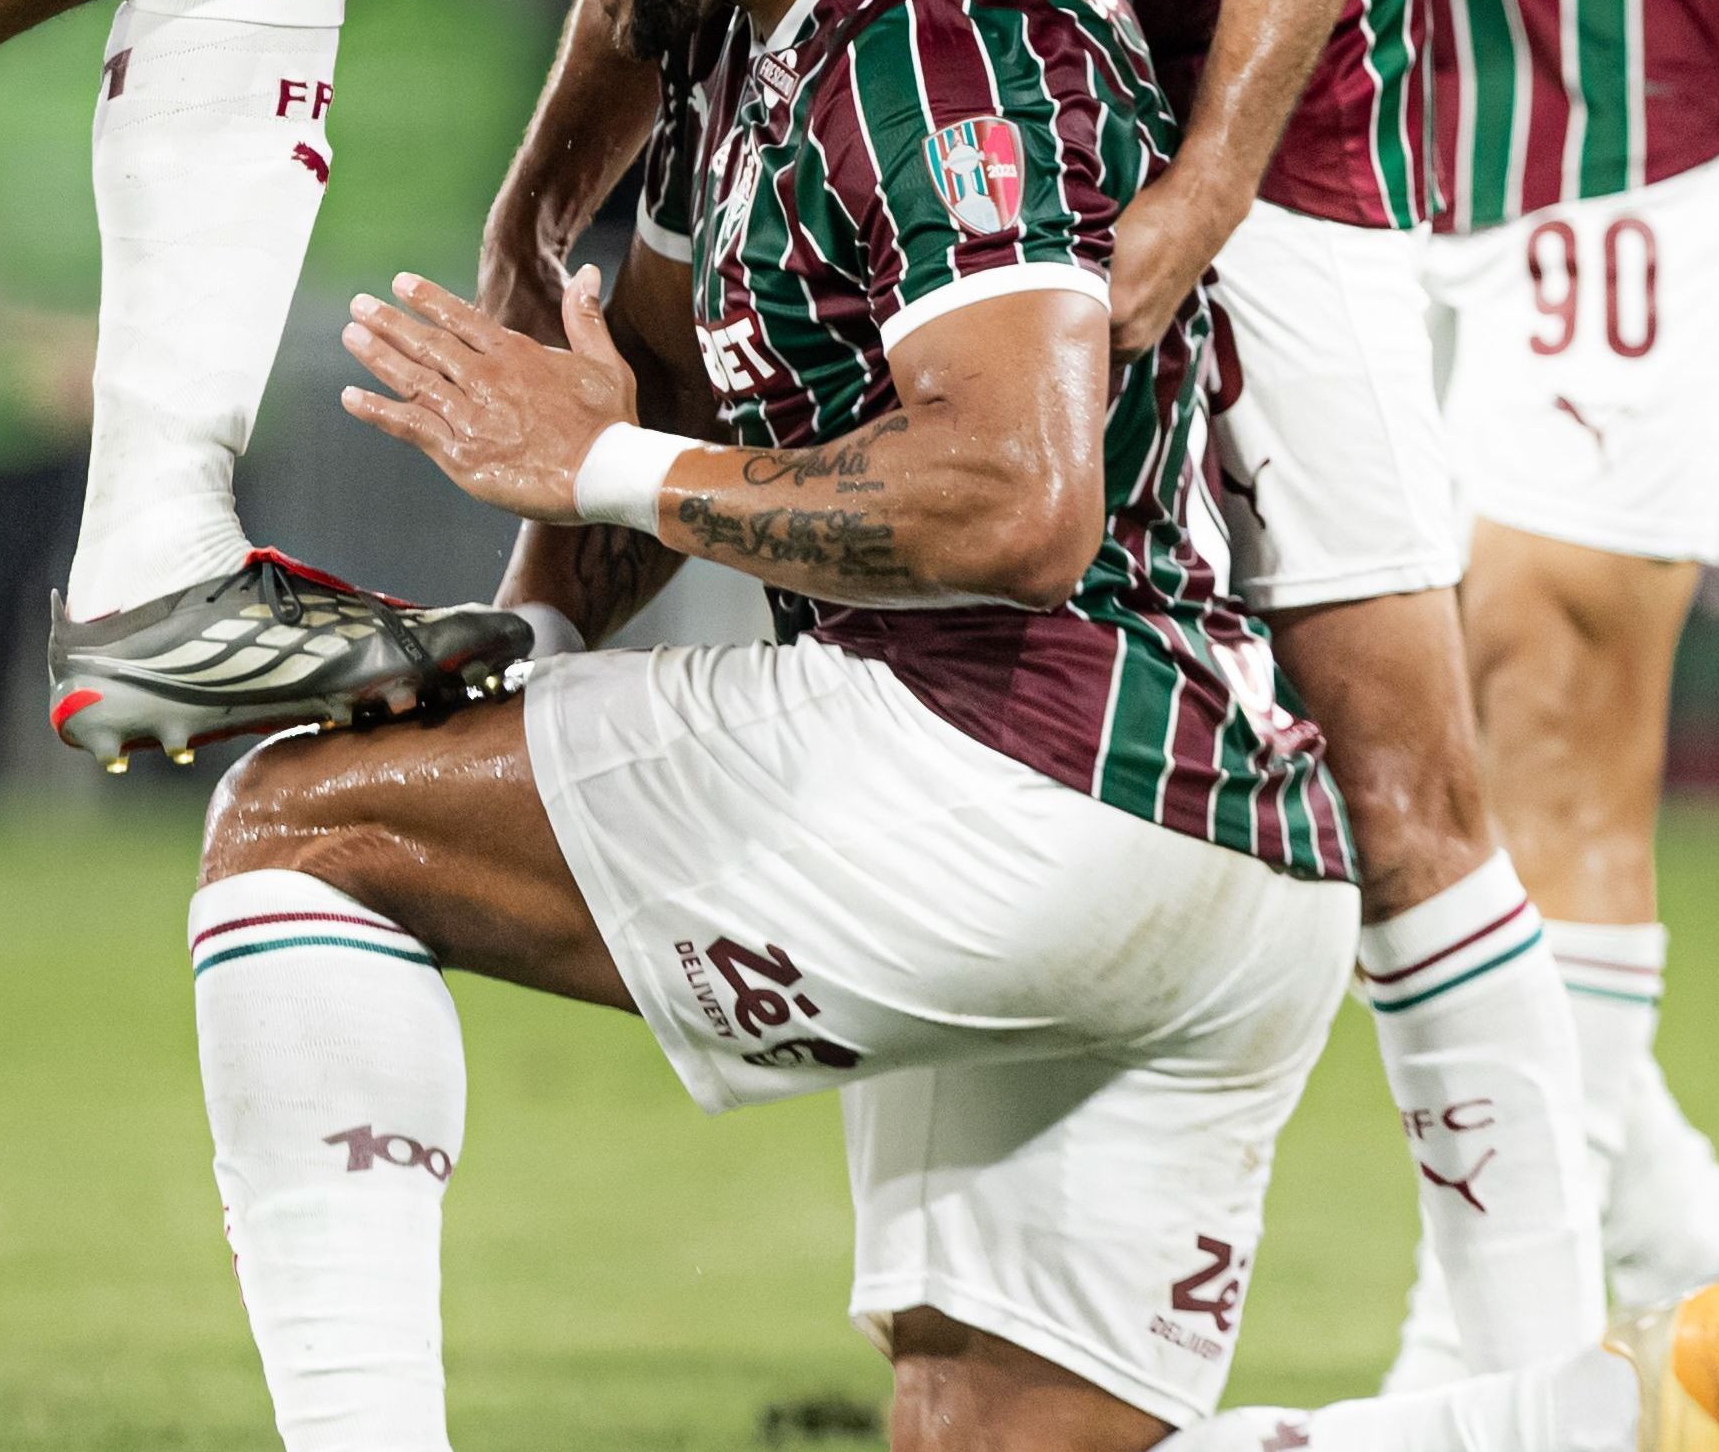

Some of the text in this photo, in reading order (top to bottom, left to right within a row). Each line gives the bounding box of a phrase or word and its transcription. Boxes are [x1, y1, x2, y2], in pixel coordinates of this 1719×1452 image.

[1528, 218, 1657, 358] 90
[674, 940, 739, 1040] DELIVERY
[321, 1124, 453, 1183] 100
